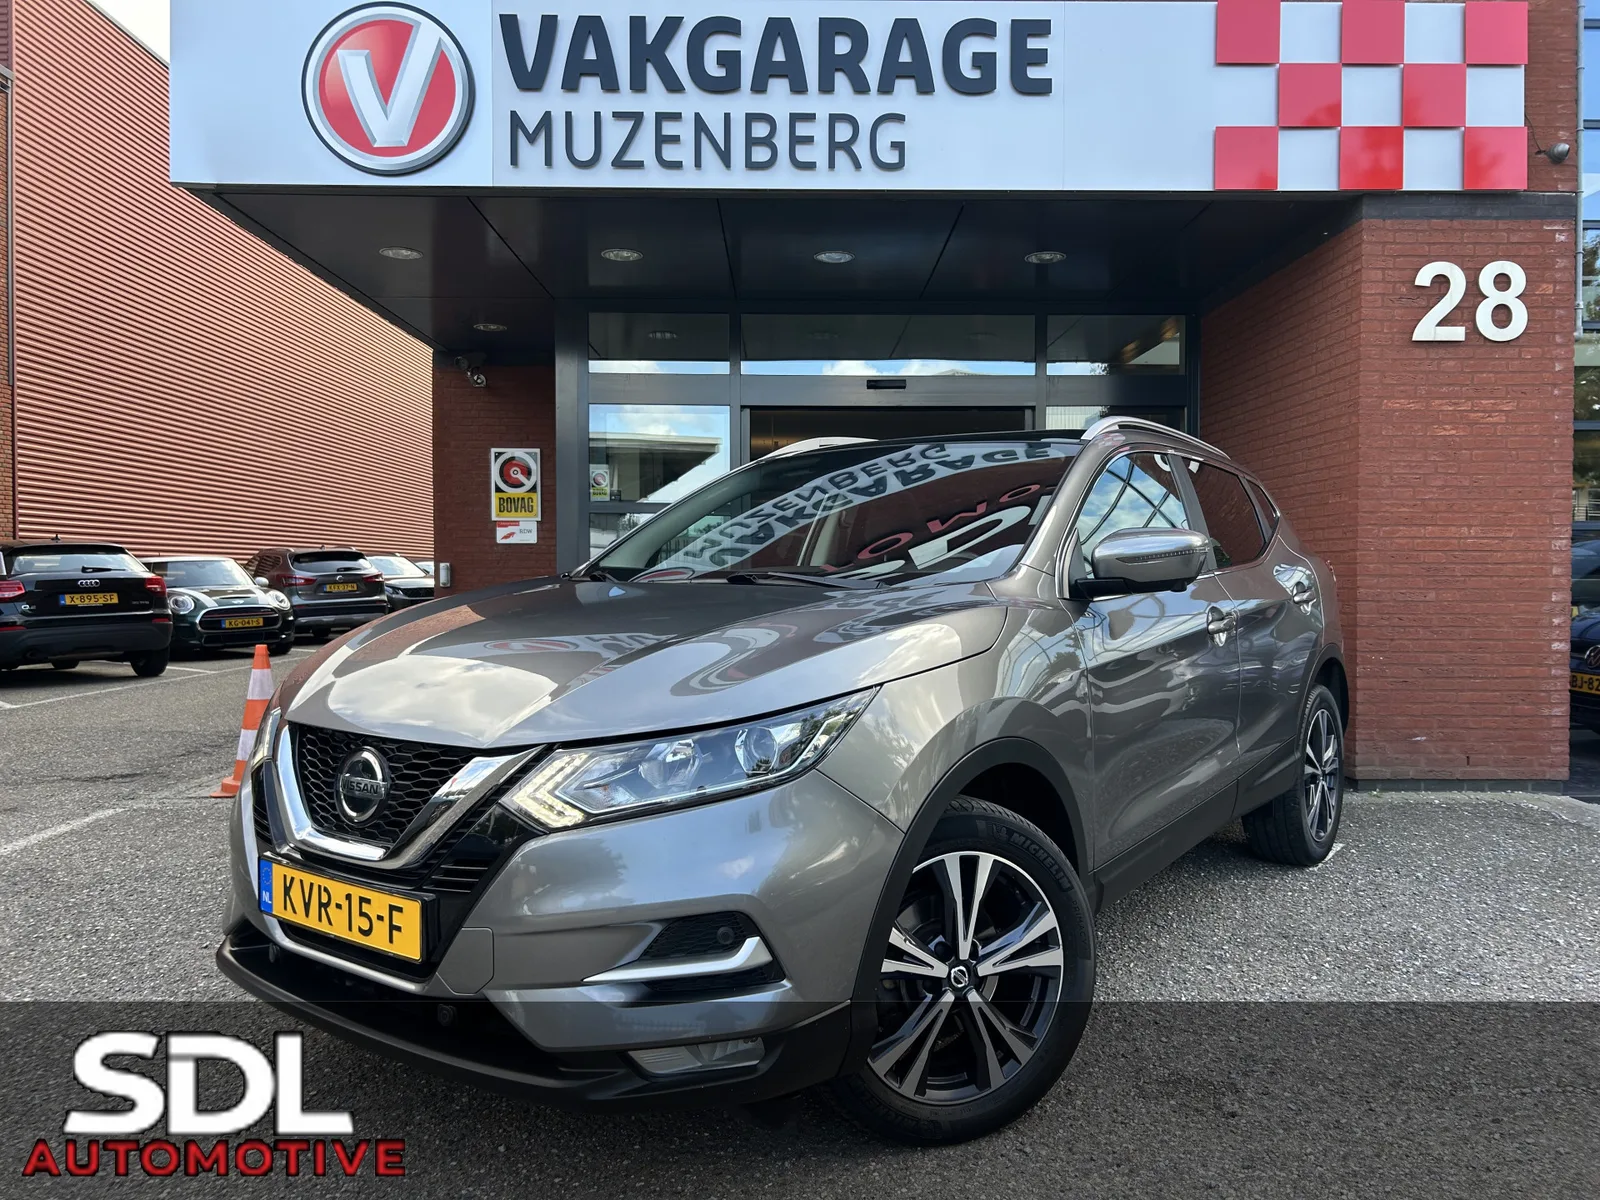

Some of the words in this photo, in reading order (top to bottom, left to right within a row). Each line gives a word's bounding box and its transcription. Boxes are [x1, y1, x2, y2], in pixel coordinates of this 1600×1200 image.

[499, 13, 1053, 95] VAKGARAGE
[508, 109, 908, 172] MUZENBERG
[1411, 260, 1529, 343] 28
[498, 497, 534, 513] BOVAG
[69, 594, 115, 604] X-895-SF
[228, 618, 261, 627] KG-041-S
[340, 777, 381, 796] NISSAN
[1010, 832, 1071, 890] MICHELIN
[262, 892, 272, 904] NL
[283, 873, 404, 945] KVR-15-F
[1071, 900, 1087, 945] PRIMACY
